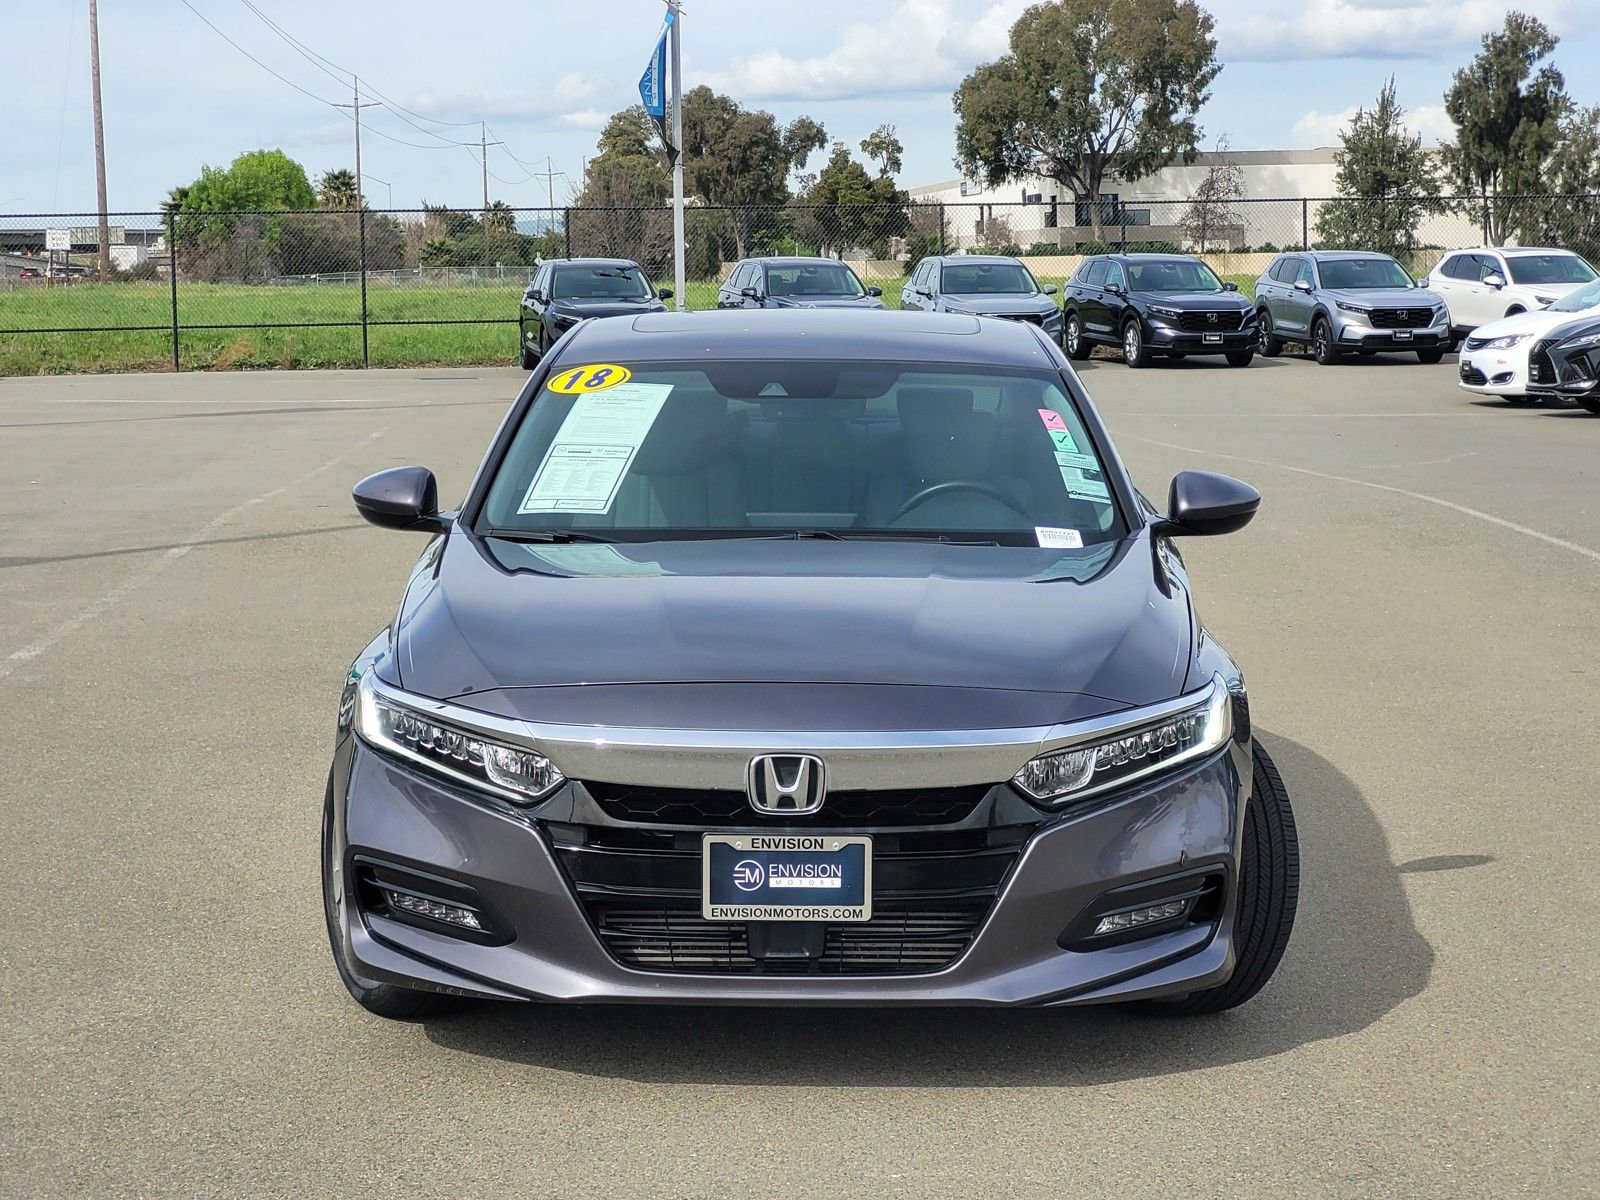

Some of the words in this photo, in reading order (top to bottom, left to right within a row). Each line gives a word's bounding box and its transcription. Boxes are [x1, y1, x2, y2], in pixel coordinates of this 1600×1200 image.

[564, 368, 614, 390] 18
[751, 838, 824, 849] ENVISION
[769, 864, 842, 877] ENVISION
[711, 907, 863, 919] ENVISIONMOTORS.COM
